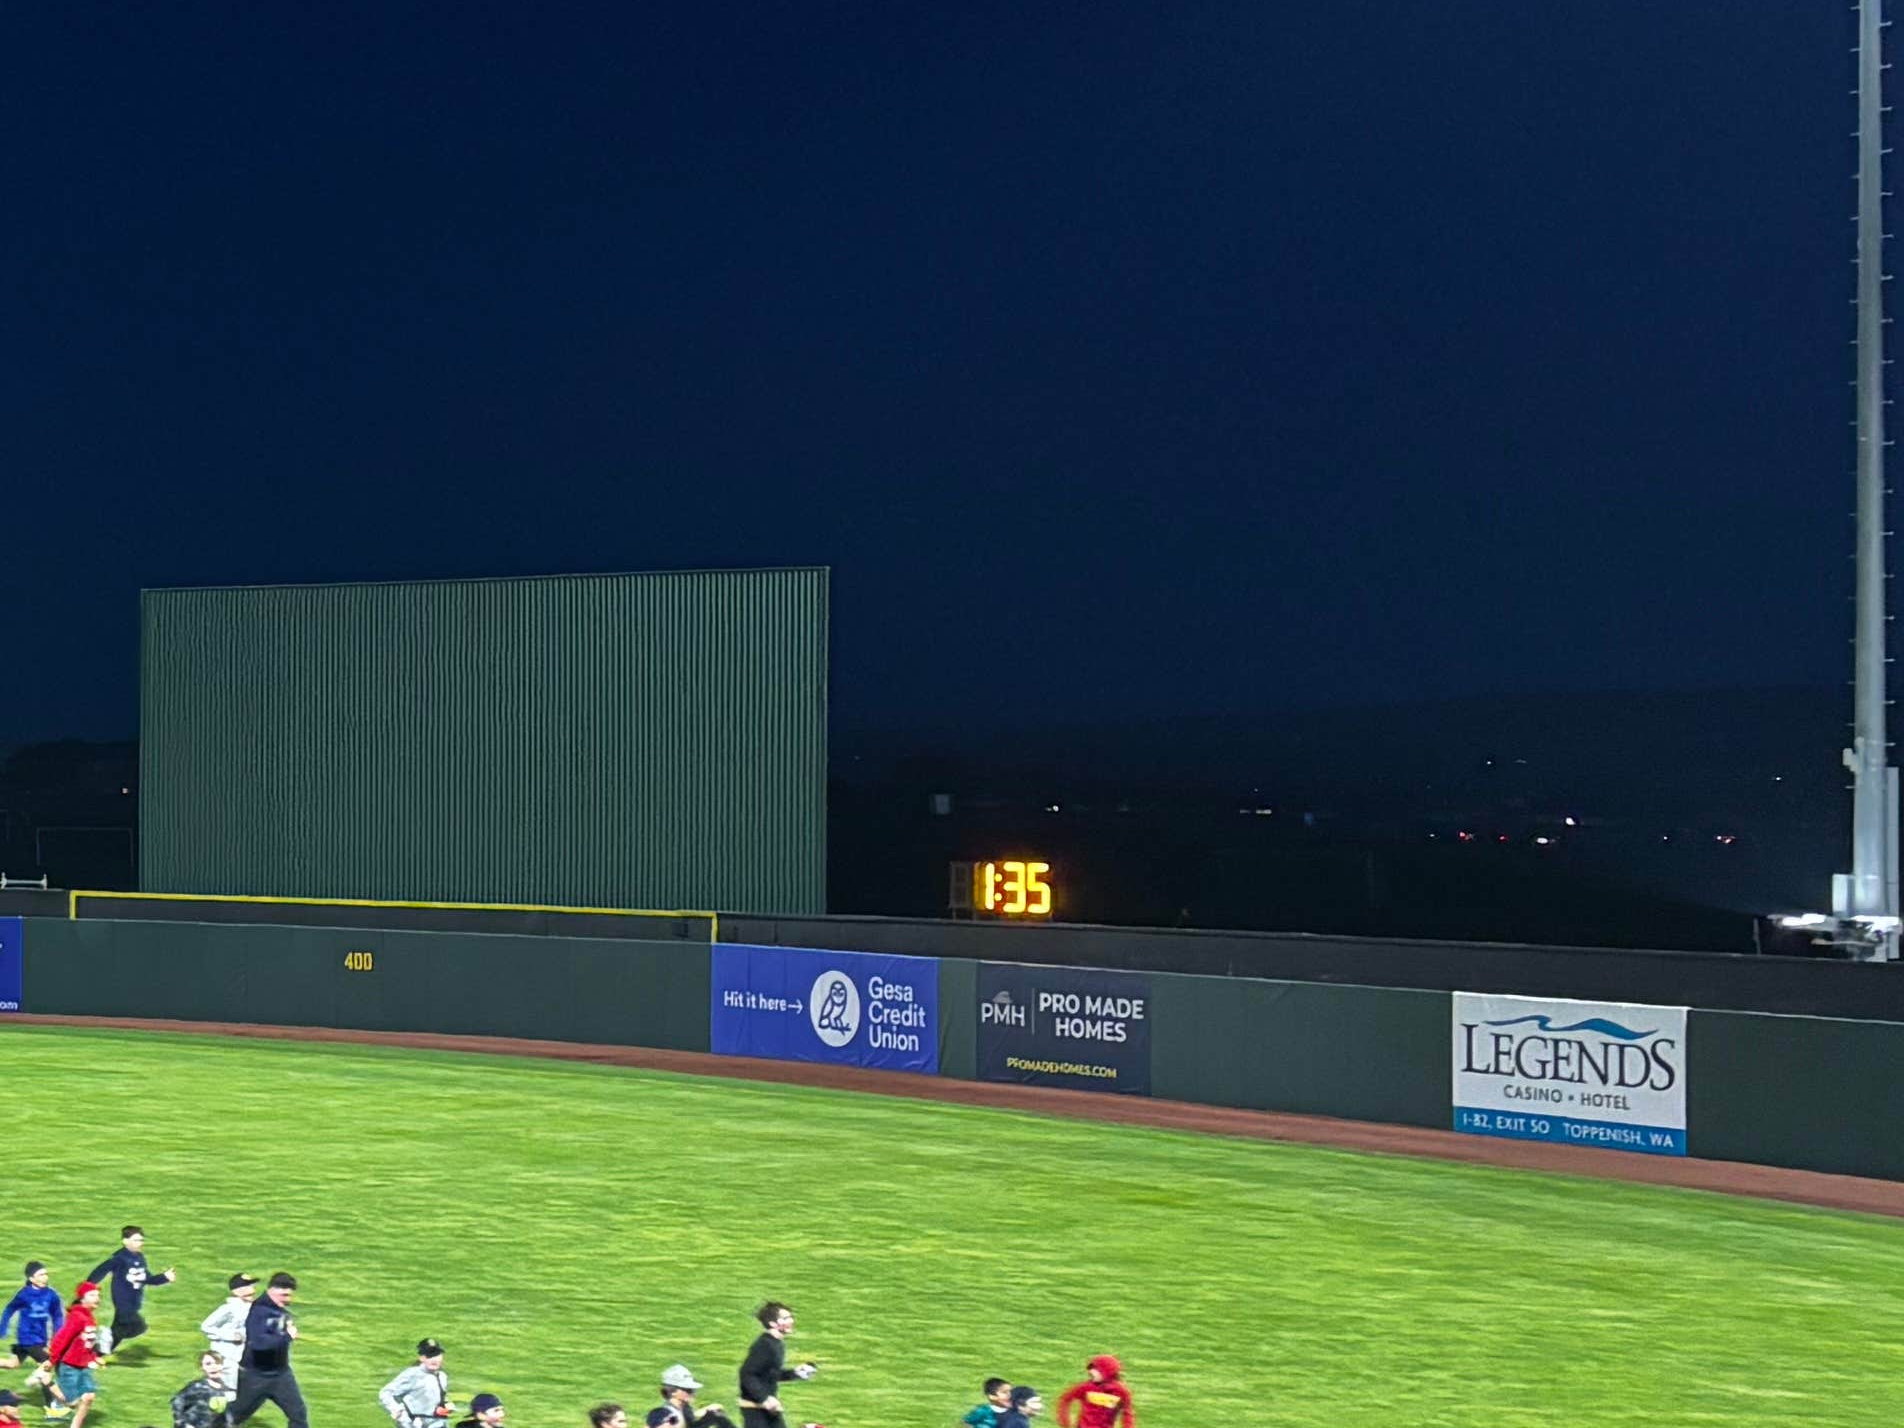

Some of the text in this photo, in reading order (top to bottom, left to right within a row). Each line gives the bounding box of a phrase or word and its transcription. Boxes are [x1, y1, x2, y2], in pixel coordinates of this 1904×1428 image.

[985, 861, 1051, 914] 1:35
[344, 952, 373, 971] 400
[723, 990, 787, 1012] Hit it here
[868, 976, 914, 1002] Gesa
[868, 1001, 926, 1028] Credit
[981, 1003, 1026, 1027] PMH
[1039, 992, 1144, 1020] PRO MADE
[868, 1025, 920, 1052] Union
[1055, 1016, 1127, 1042] HOMES
[1007, 1057, 1117, 1079] PROMADEHOMES.COM
[1460, 1023, 1676, 1092] LEGENDS
[1503, 1084, 1631, 1110] CASINO HOTEL
[1496, 1115, 1526, 1132] EXIT
[1531, 1120, 1551, 1134] 50
[1649, 1132, 1674, 1148] WA
